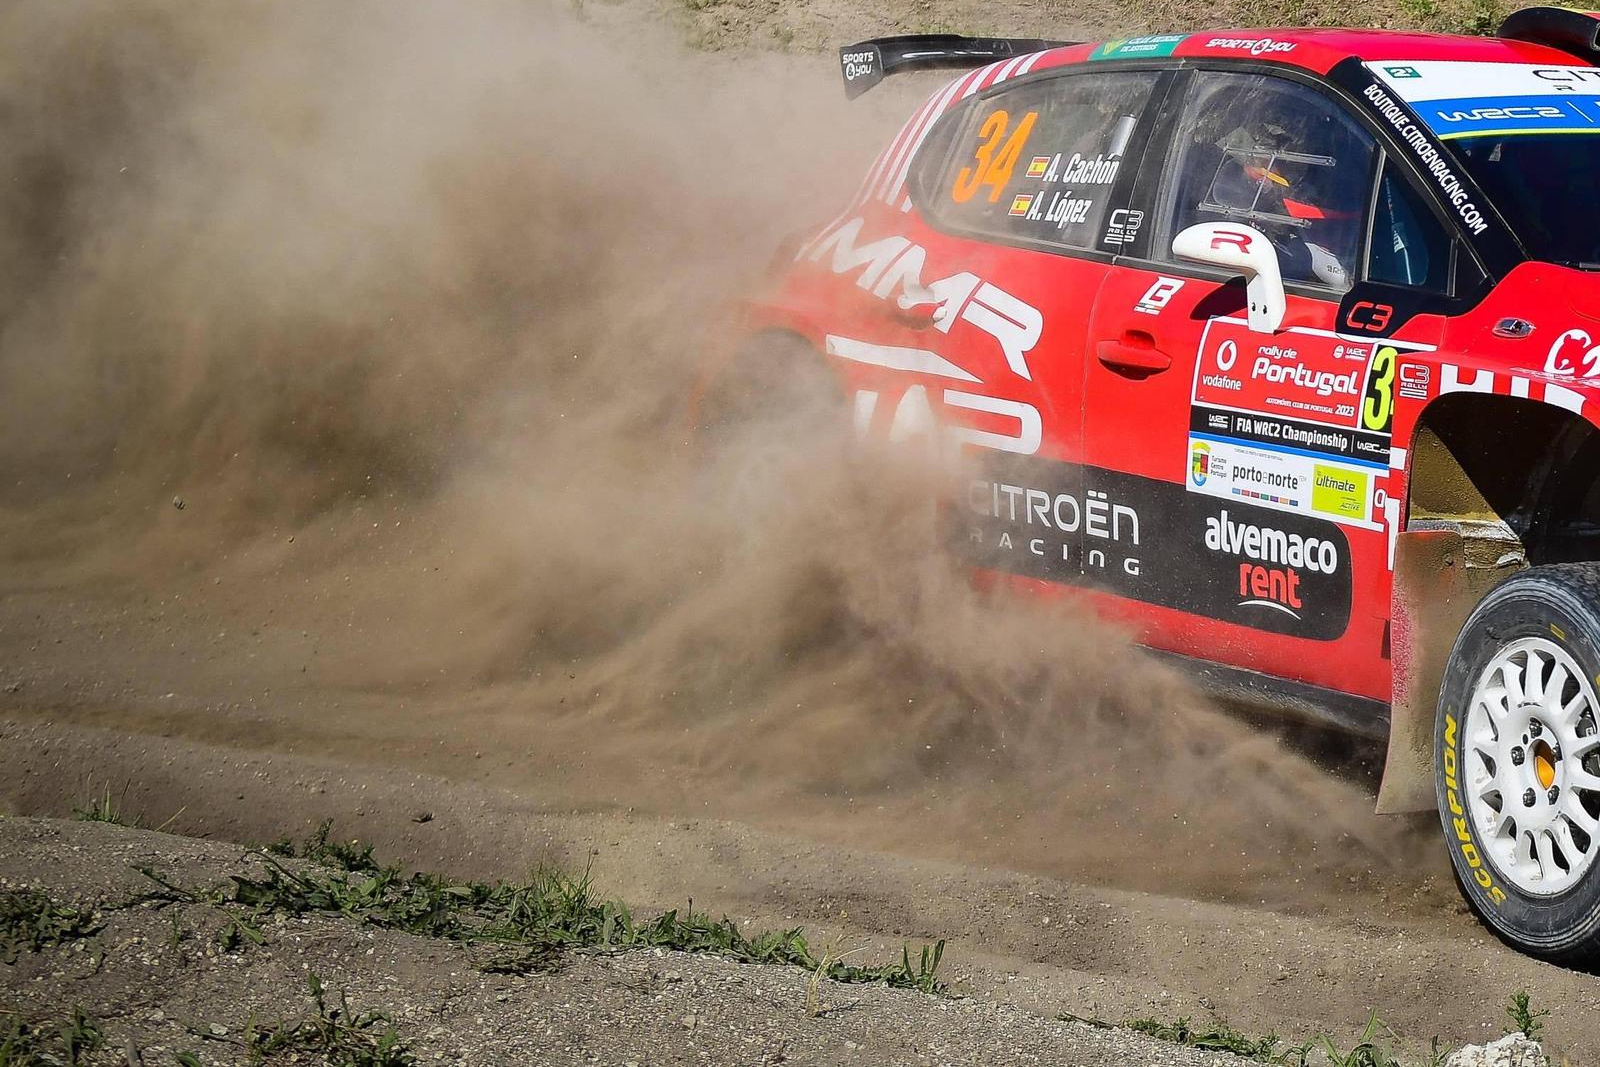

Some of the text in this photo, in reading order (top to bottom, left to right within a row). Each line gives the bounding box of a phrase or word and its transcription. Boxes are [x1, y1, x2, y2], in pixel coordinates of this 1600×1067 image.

[842, 51, 874, 64] SPORTS
[1437, 106, 1566, 122] WRC2
[952, 110, 1040, 204] 34
[1042, 152, 1120, 185] A. Cachón
[1363, 83, 1488, 236] BOUTIQUE.CITROENRACING.COM
[1025, 190, 1093, 229] A. López
[1109, 208, 1144, 230] C3
[808, 217, 1043, 381] MMR
[1346, 301, 1393, 330] C3
[1258, 345, 1298, 360] rally de
[1202, 374, 1242, 390] vodafone
[1251, 357, 1359, 397] Portugal
[1363, 346, 1398, 431] 3
[1399, 363, 1430, 383] C3
[1400, 382, 1428, 390] RALLY
[1335, 404, 1355, 417] 2023
[1236, 417, 1348, 452] FIA WRC2 Championship
[1316, 475, 1356, 493] ultimate
[968, 481, 1140, 545] CITROËN
[970, 521, 1140, 576] RACING
[1204, 509, 1338, 574] alvemaco
[1239, 562, 1302, 609] rent
[1444, 714, 1508, 907] SCORPION
